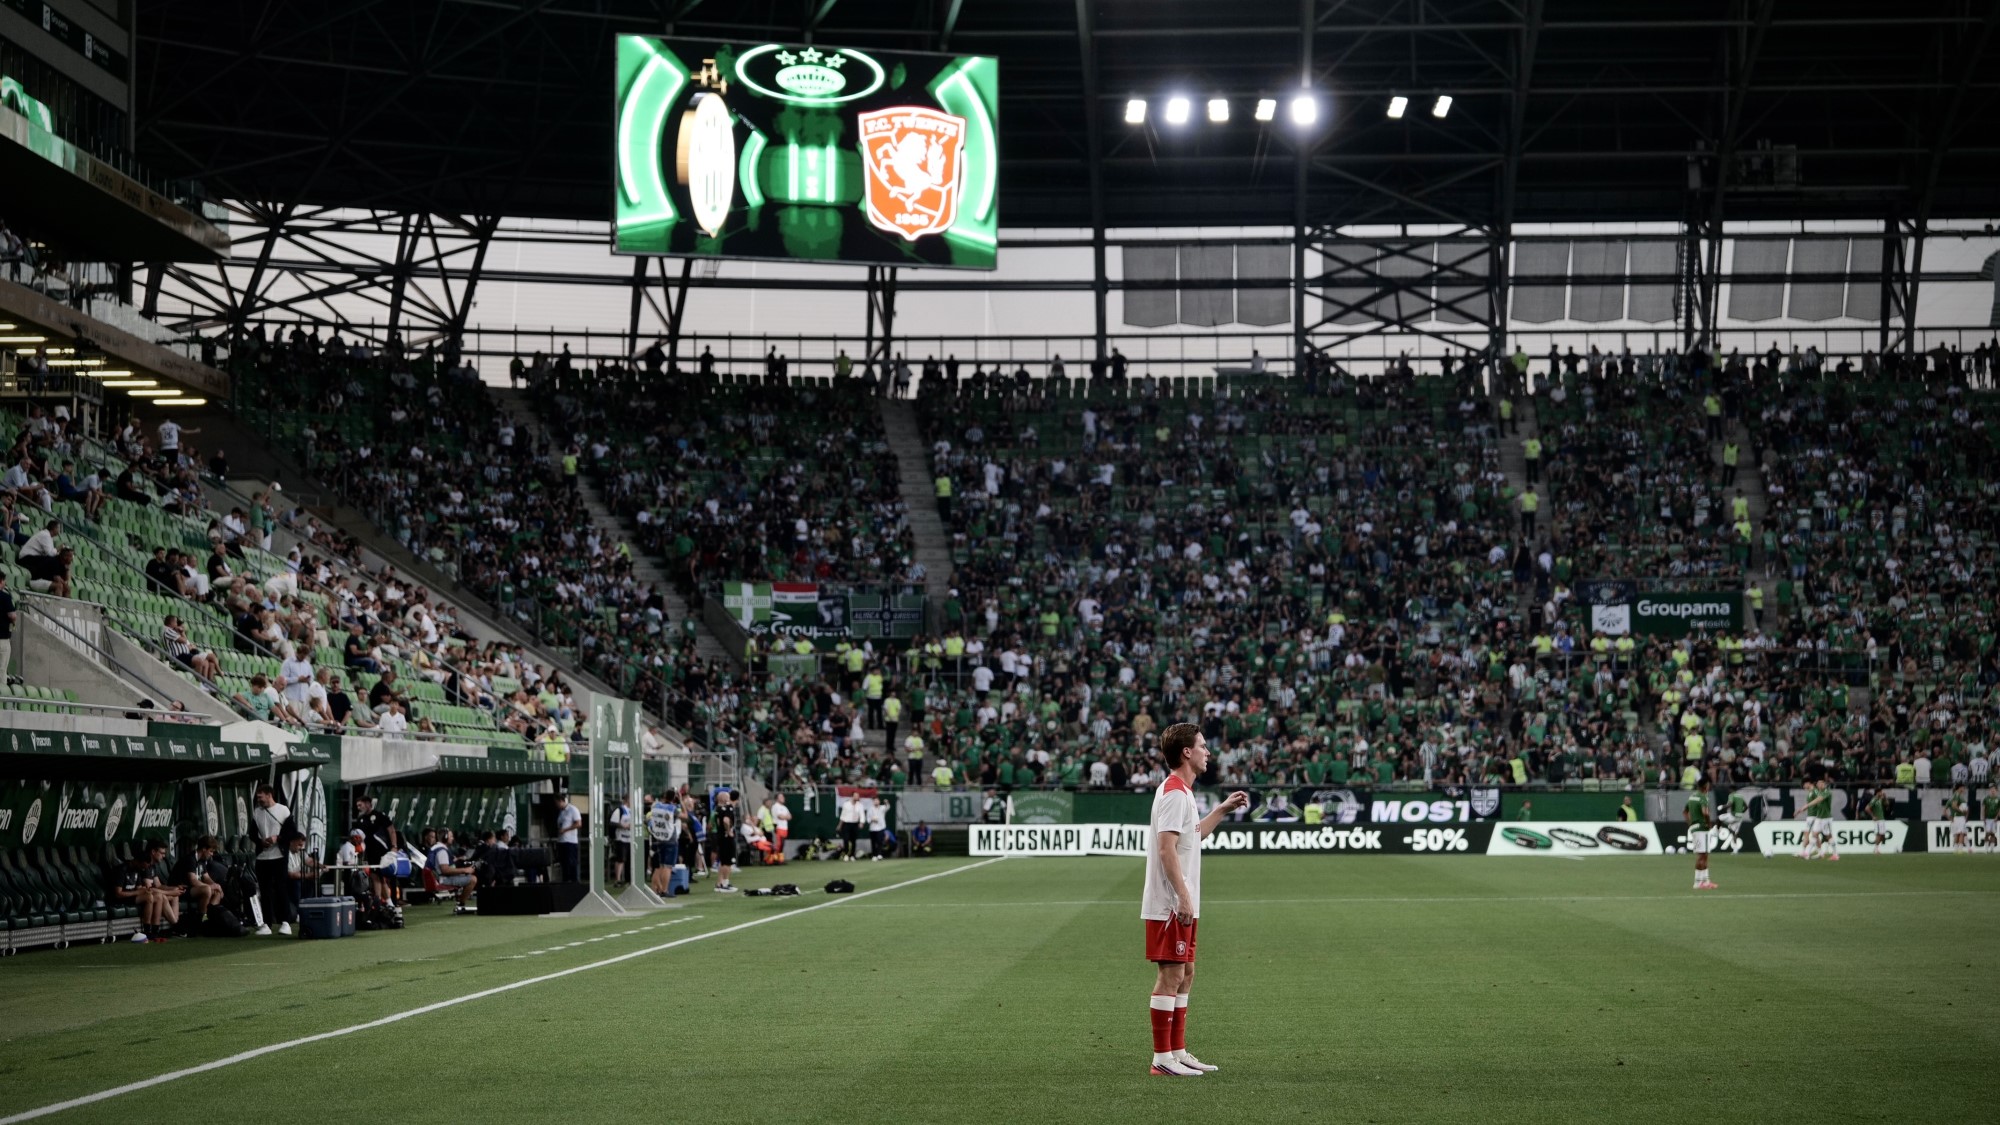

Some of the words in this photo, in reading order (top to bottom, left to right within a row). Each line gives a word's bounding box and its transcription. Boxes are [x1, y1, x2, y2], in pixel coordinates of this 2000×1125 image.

[1637, 600, 1730, 619] Groupama
[771, 621, 851, 640] Groupm
[950, 796, 975, 818] B1
[1371, 801, 1470, 823] MOST
[63, 808, 99, 829] macron
[142, 808, 173, 828] macron
[978, 829, 1080, 851] MECCSNAPI
[1201, 831, 1253, 850] RADI
[1260, 826, 1382, 850] KARKÖTŐK
[1403, 828, 1469, 851] -50%
[1772, 831, 1827, 845] FRA
